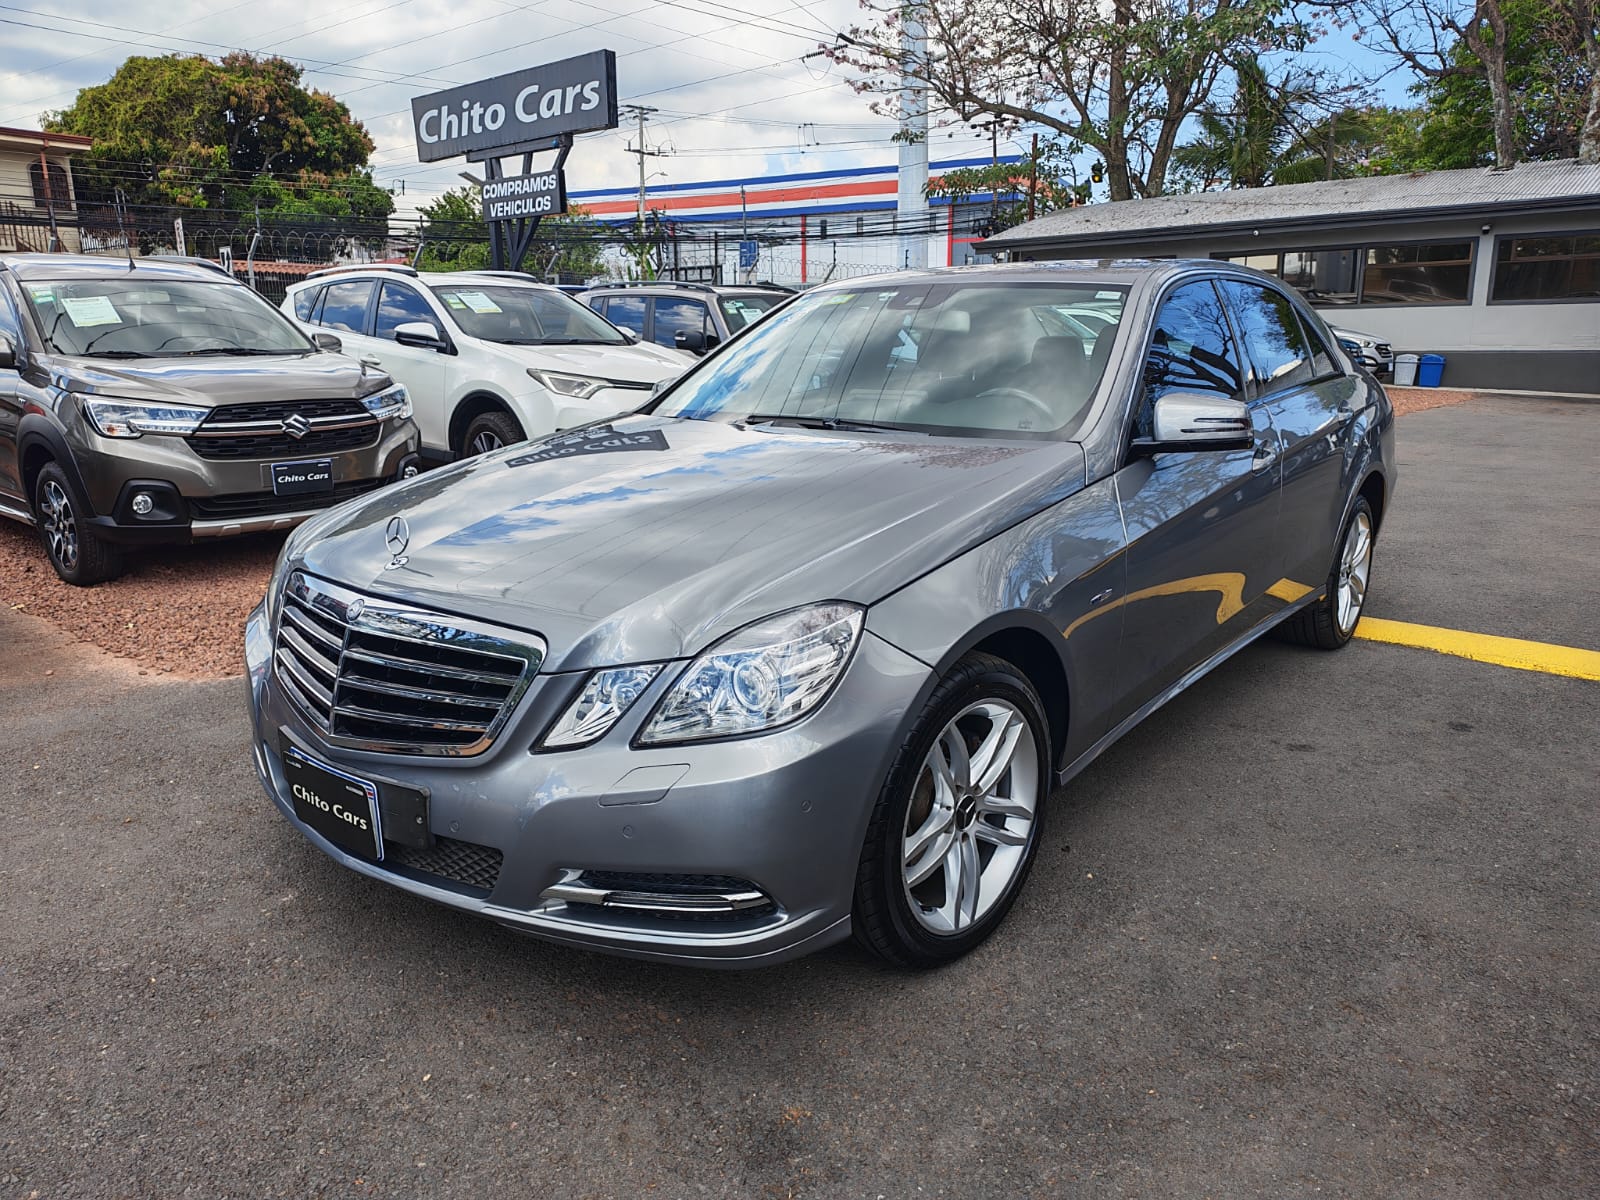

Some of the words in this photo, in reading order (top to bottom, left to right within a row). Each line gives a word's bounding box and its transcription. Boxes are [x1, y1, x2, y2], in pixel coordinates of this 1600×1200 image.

[419, 100, 506, 144] Chito
[514, 80, 600, 123] Cars
[482, 173, 557, 200] COMPRAMOS
[490, 195, 552, 218] VEHICULOS
[278, 475, 305, 483] Chito
[293, 784, 329, 811] Chito
[333, 805, 367, 829] Cars
